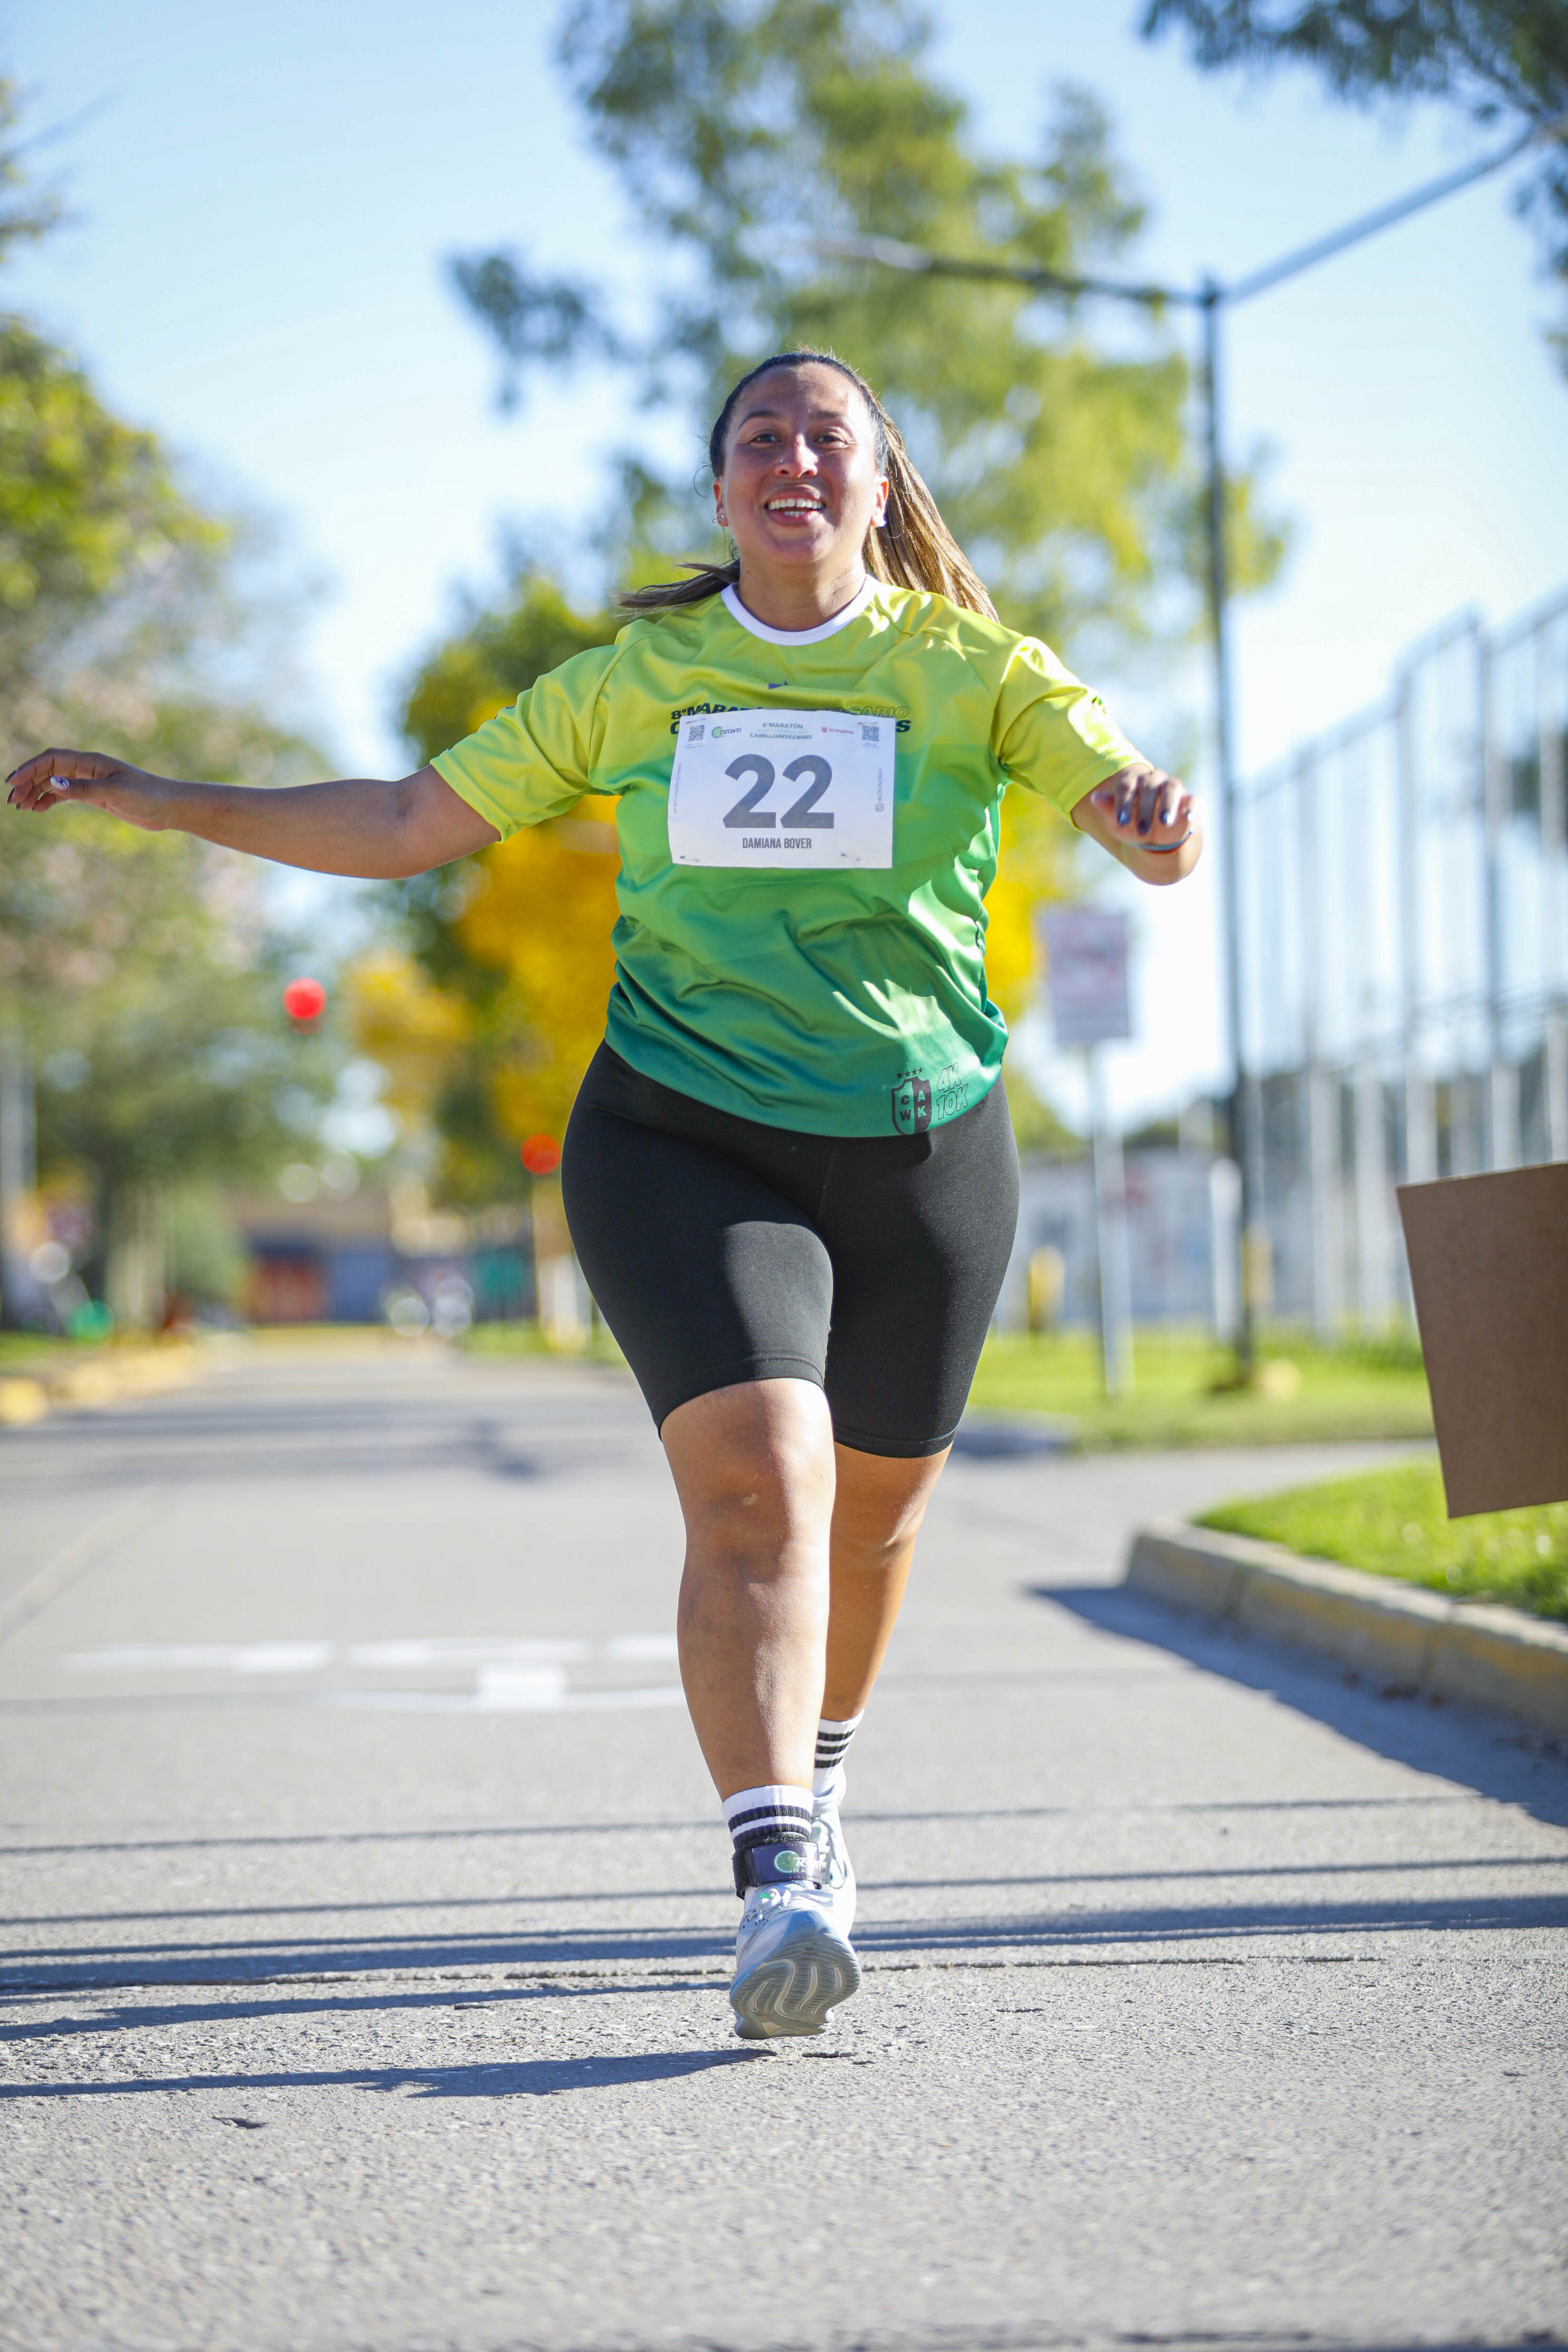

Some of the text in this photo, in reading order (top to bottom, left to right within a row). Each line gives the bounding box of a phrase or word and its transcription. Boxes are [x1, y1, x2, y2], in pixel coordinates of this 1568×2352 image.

[722, 753, 834, 829] 22
[742, 837, 812, 849] DAMIANA BOVER
[937, 1062, 962, 1093] 4K
[936, 1083, 968, 1120] 10K
